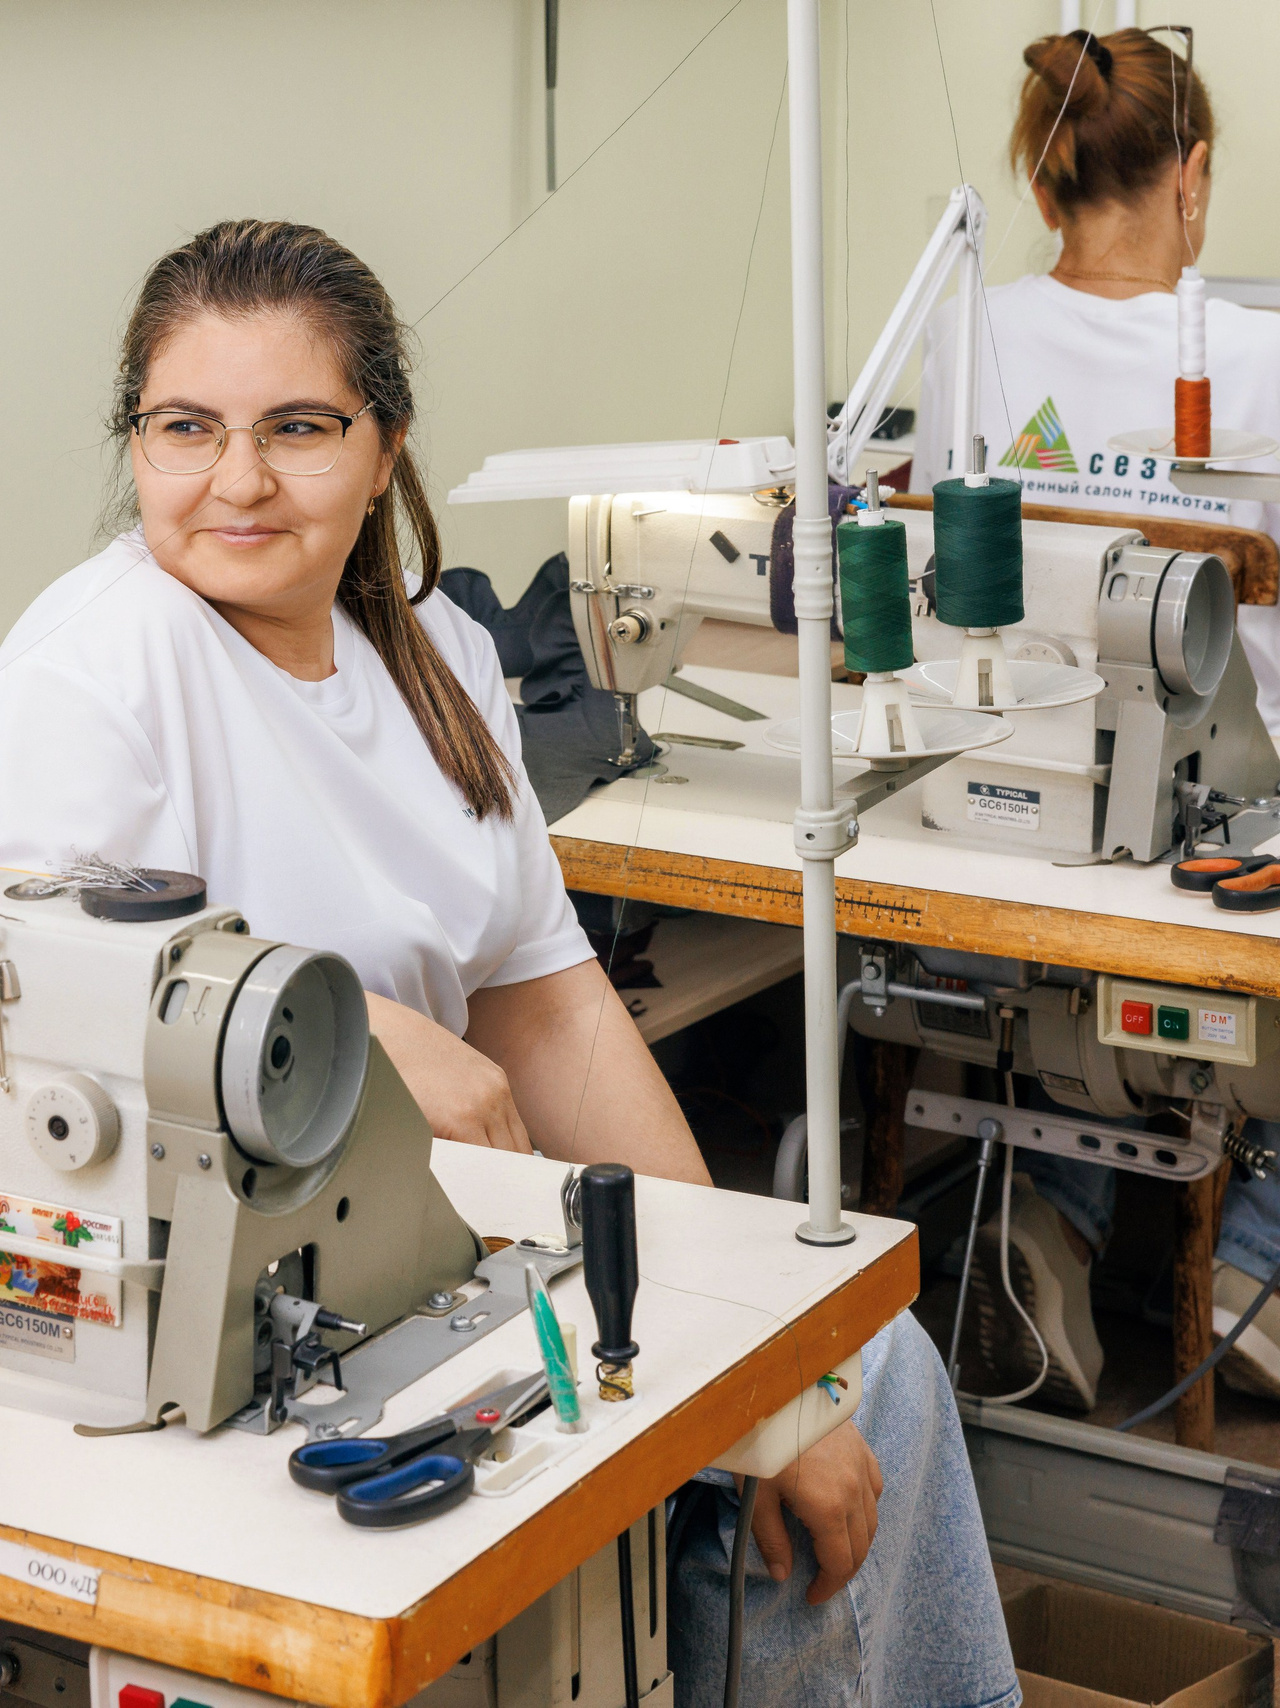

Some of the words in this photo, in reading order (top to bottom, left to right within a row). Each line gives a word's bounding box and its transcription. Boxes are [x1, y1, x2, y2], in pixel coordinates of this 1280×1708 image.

[1085, 484, 1132, 499] салон
[995, 788, 1028, 800] TYPICAL
[978, 798, 1029, 815] GC6150H
[1125, 1013, 1144, 1024] OFF
[1163, 1019, 1180, 1030] ON
[50, 1090, 56, 1101] 2
[28, 1559, 67, 1585] ООО
